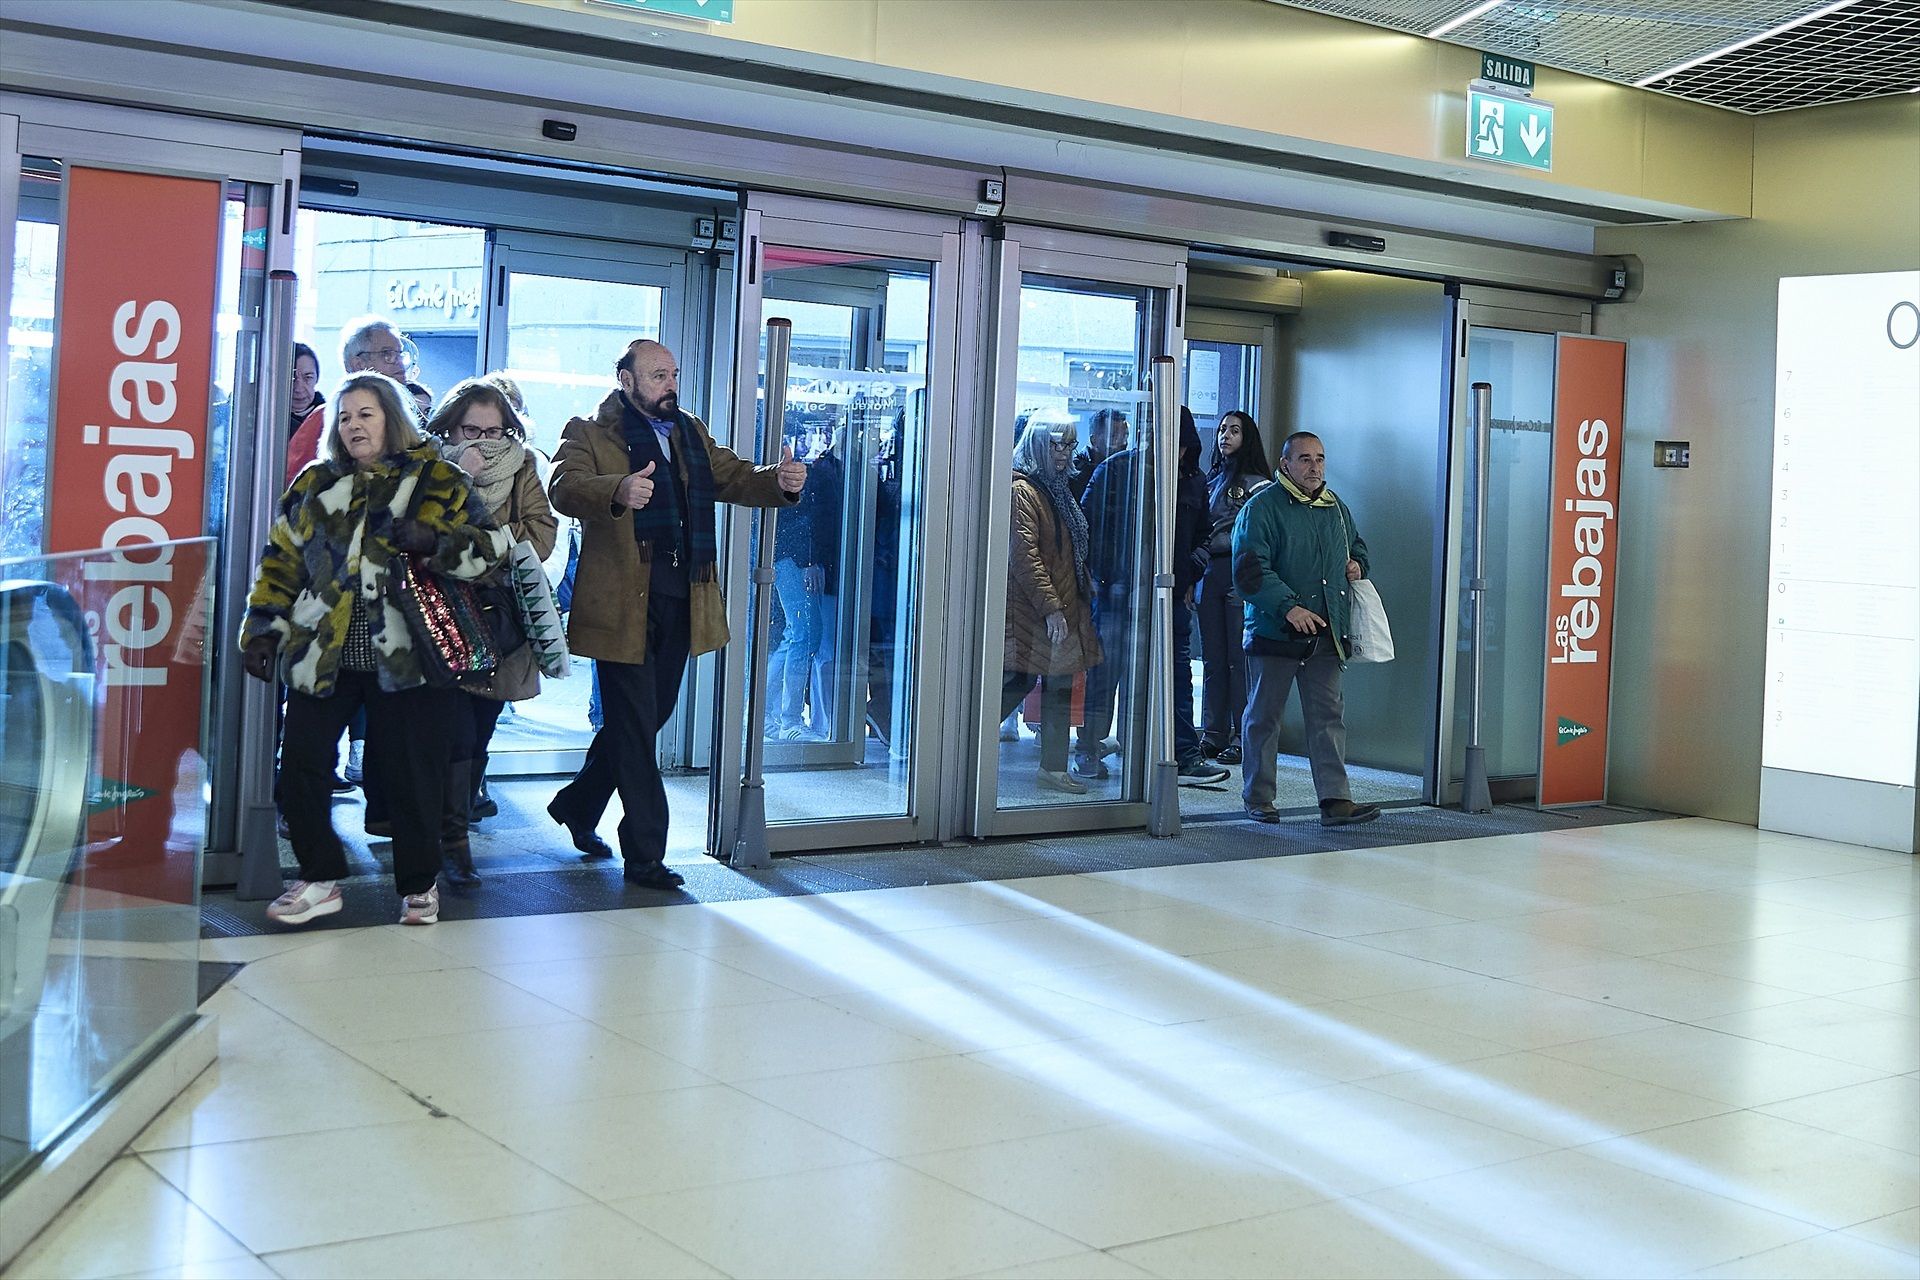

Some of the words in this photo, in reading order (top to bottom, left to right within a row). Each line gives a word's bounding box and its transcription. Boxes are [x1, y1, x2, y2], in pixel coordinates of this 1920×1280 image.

[1486, 59, 1530, 86] SALIDA
[386, 278, 403, 310] El
[403, 279, 444, 310] Corte
[1784, 370, 1793, 381] 7
[1783, 407, 1792, 419] 6
[1783, 435, 1791, 446] 5
[1781, 462, 1789, 473] 4
[84, 299, 194, 686] rebajas
[1780, 489, 1788, 501] 3
[1780, 516, 1788, 528] 2
[1561, 418, 1614, 663] rebajas
[1551, 614, 1569, 663] Las
[1777, 671, 1784, 683] 2
[1775, 710, 1783, 722] 3
